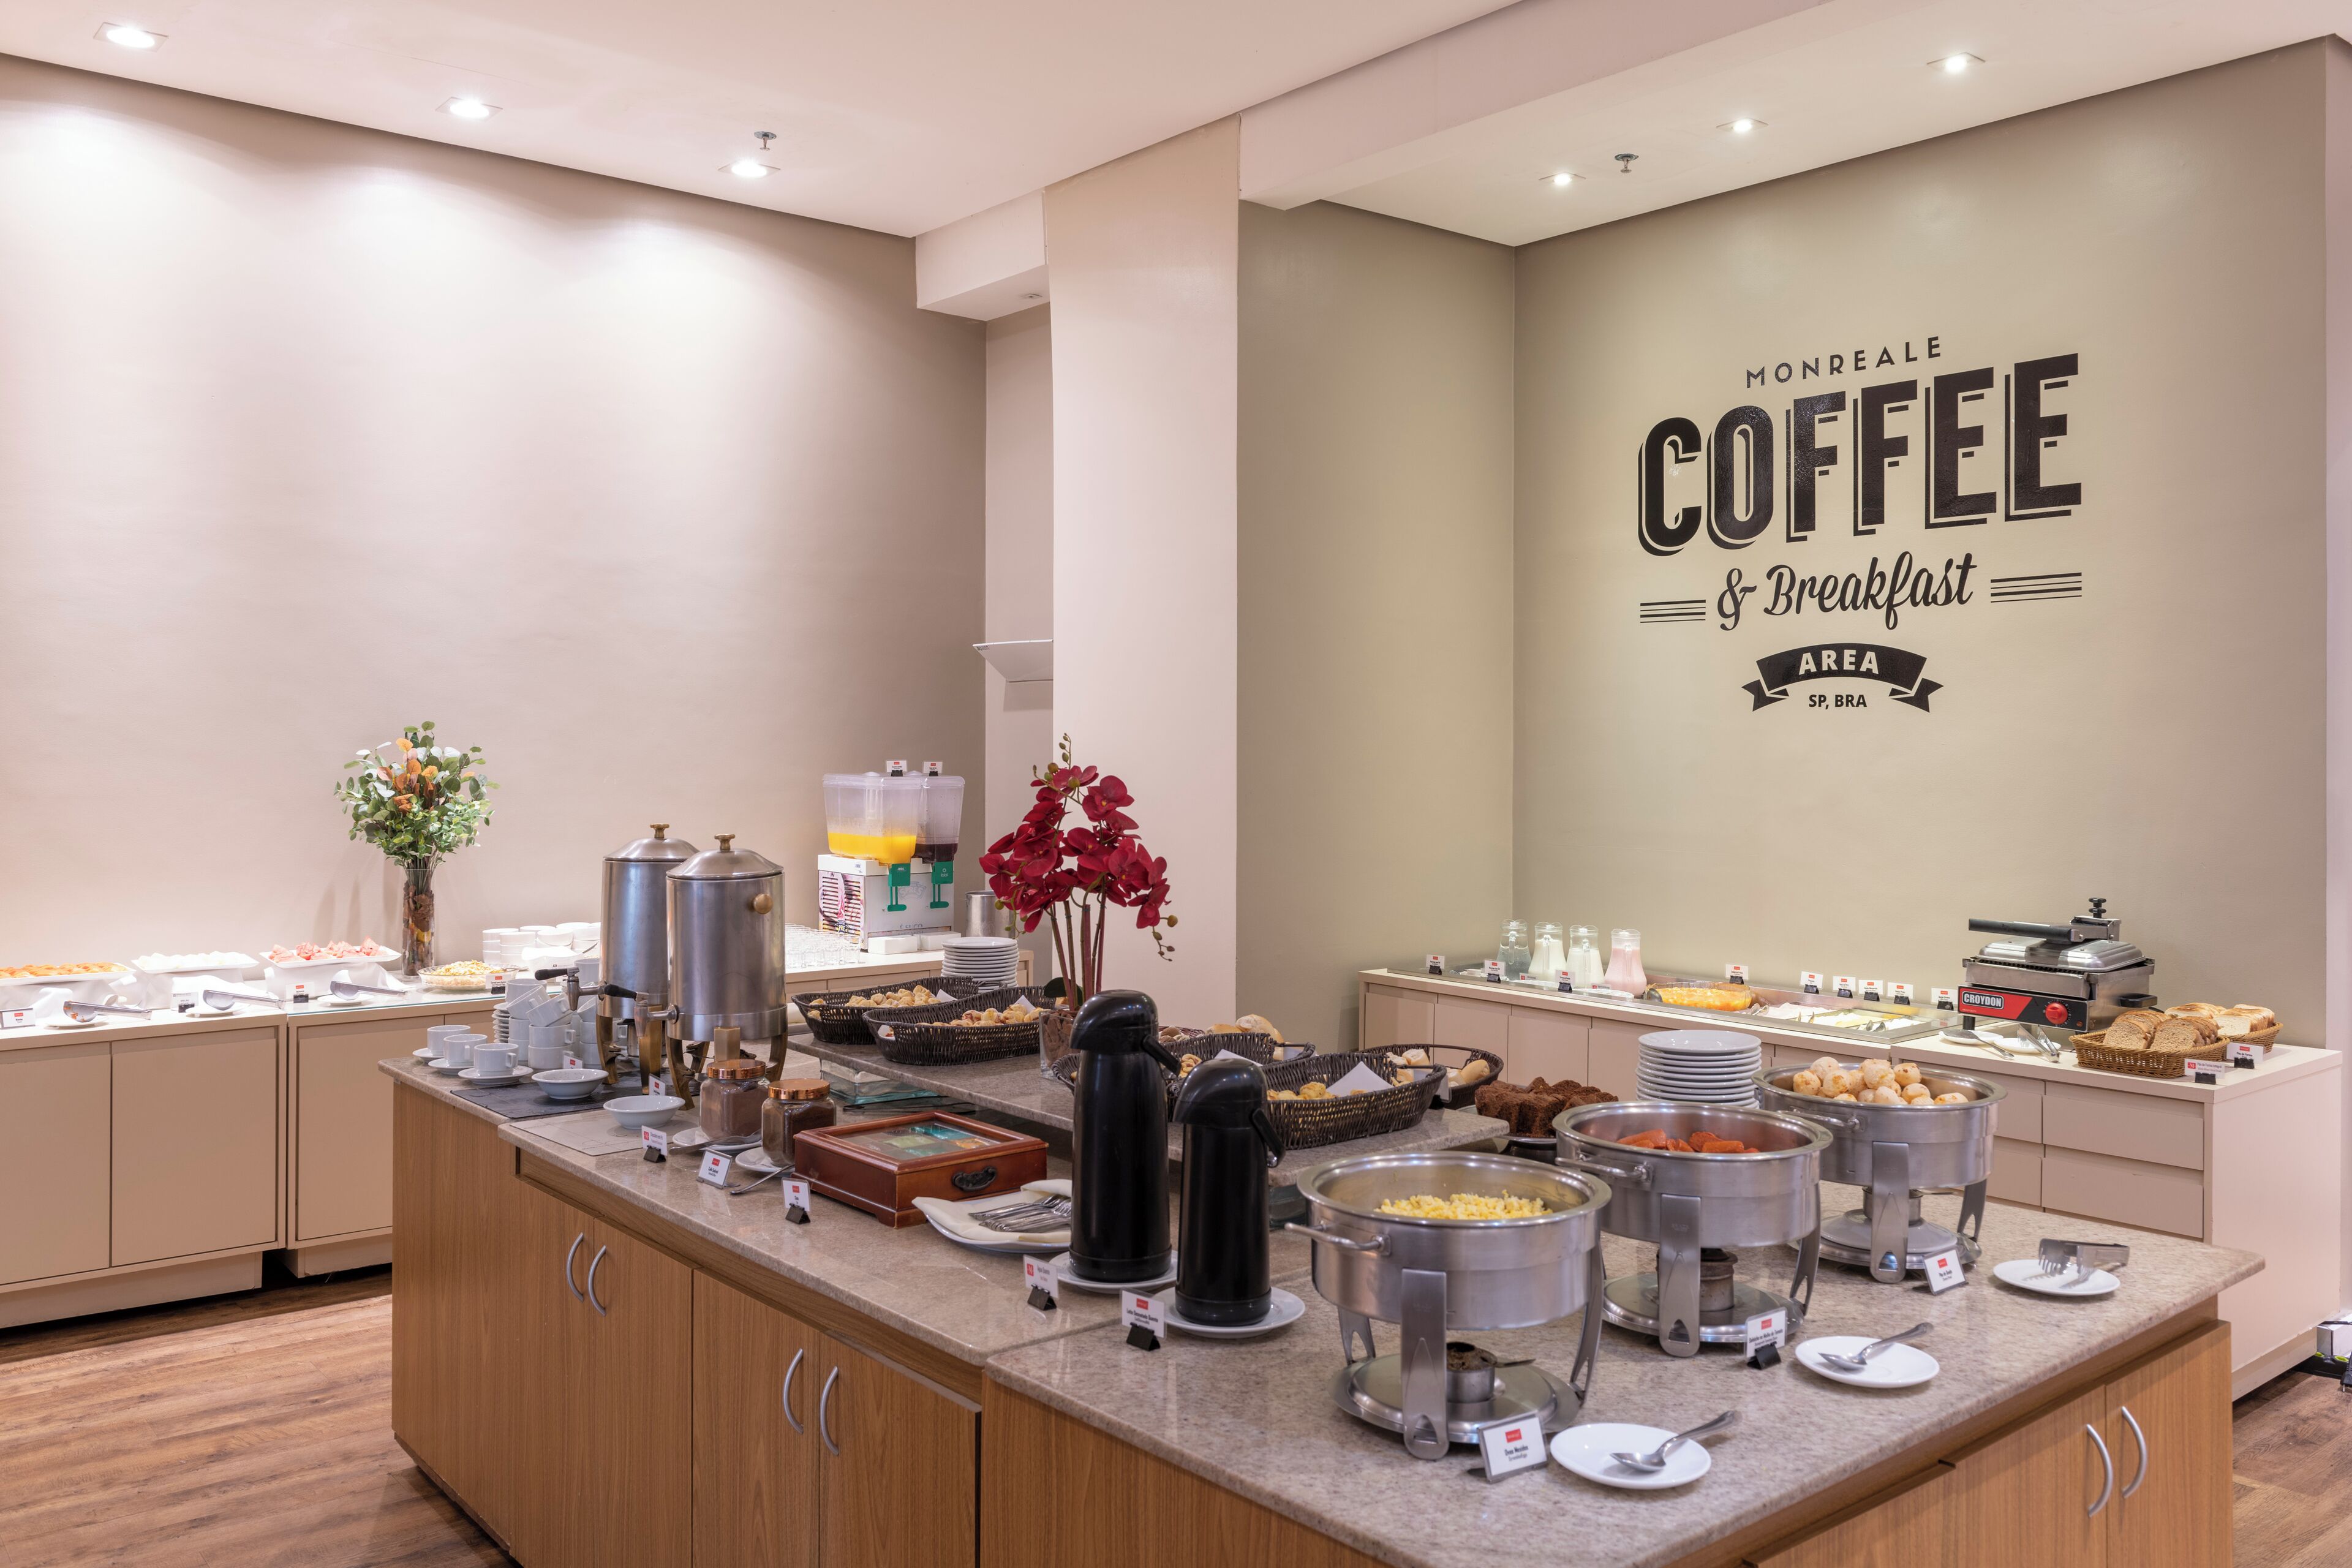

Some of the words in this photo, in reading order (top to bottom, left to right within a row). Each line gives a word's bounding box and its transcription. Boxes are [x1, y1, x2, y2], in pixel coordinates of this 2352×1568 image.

[1746, 336, 1942, 389] MONREALE
[1638, 353, 2082, 556] COFFEE
[1717, 567, 1757, 631] &
[1763, 551, 1977, 630] Breakfast
[1798, 649, 1879, 676] AREA
[1808, 694, 1830, 711] SP,
[1834, 694, 1868, 708] BRA
[1964, 993, 2002, 1007] CROYDON
